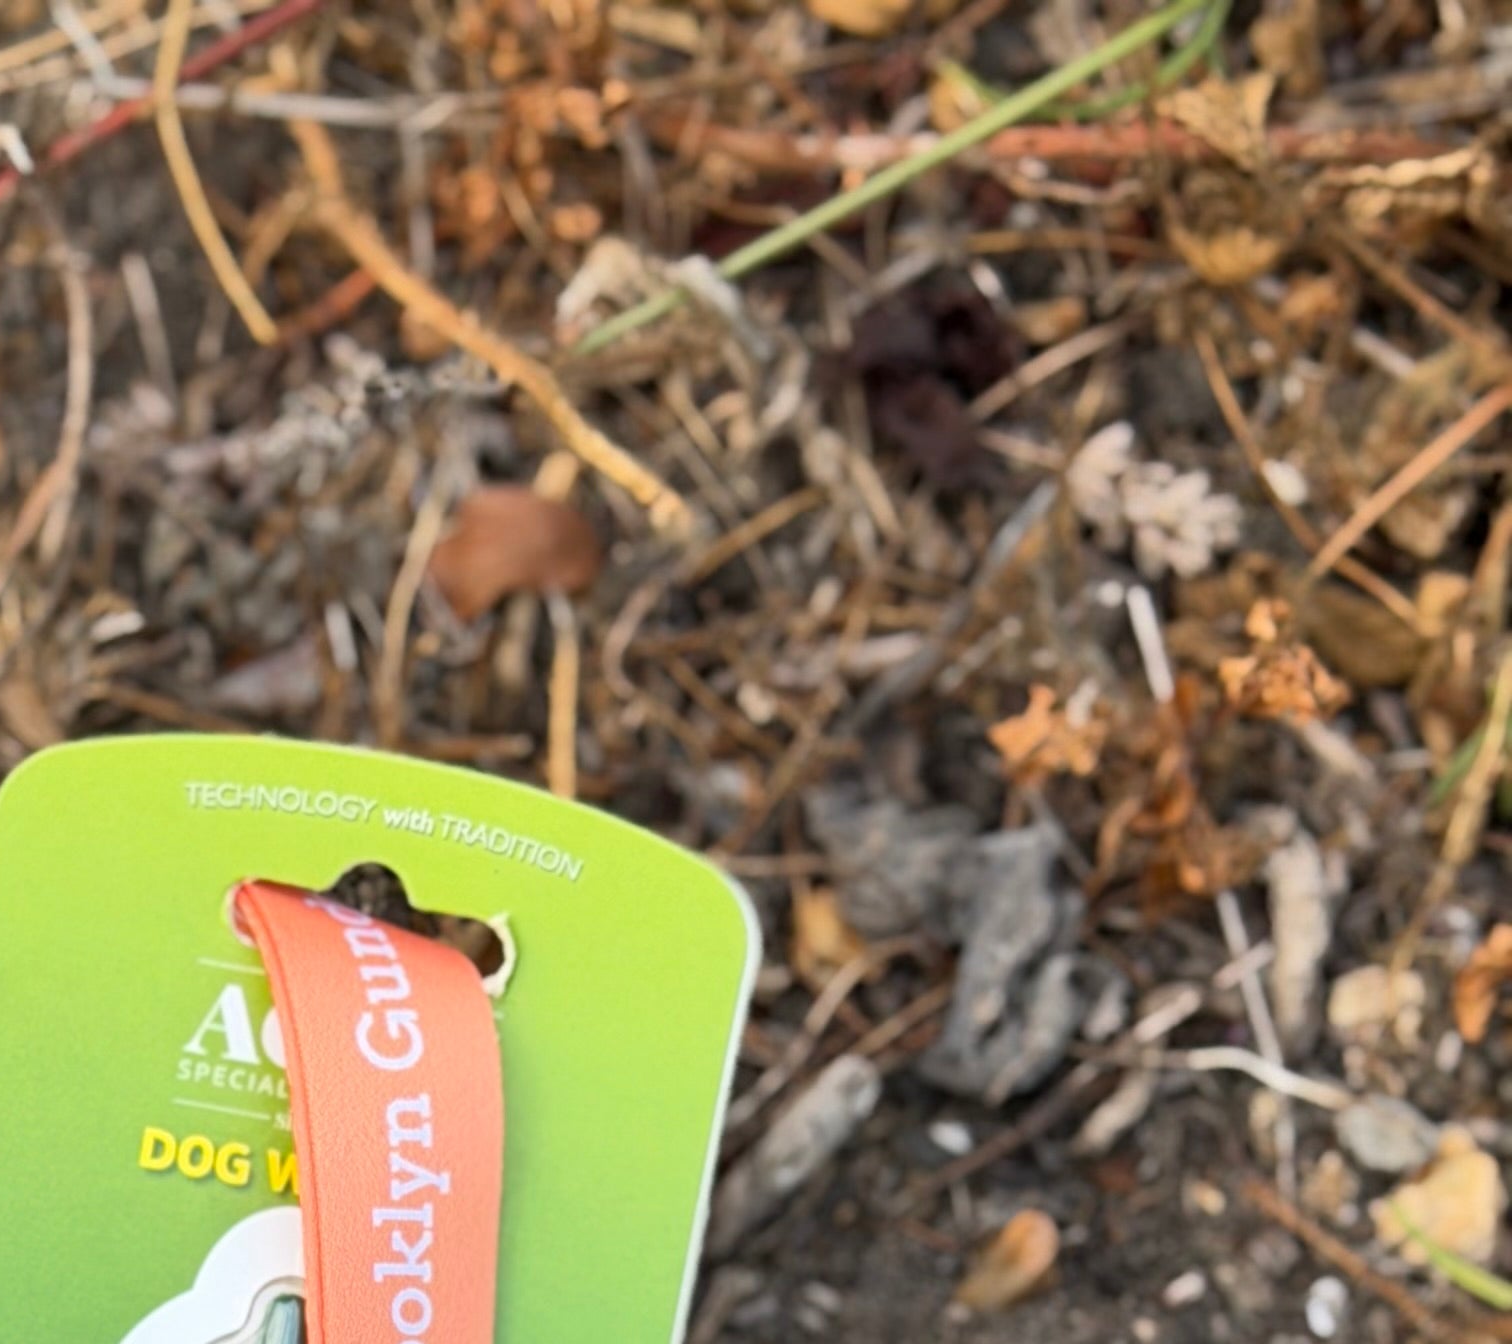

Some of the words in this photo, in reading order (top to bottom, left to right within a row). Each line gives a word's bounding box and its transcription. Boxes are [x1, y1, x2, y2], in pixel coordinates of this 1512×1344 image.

[184, 782, 378, 822] TECHNOLOGY
[381, 807, 435, 837] with
[440, 813, 584, 881] TRADITION
[182, 982, 287, 1068] A
[139, 1125, 251, 1187] DOG
